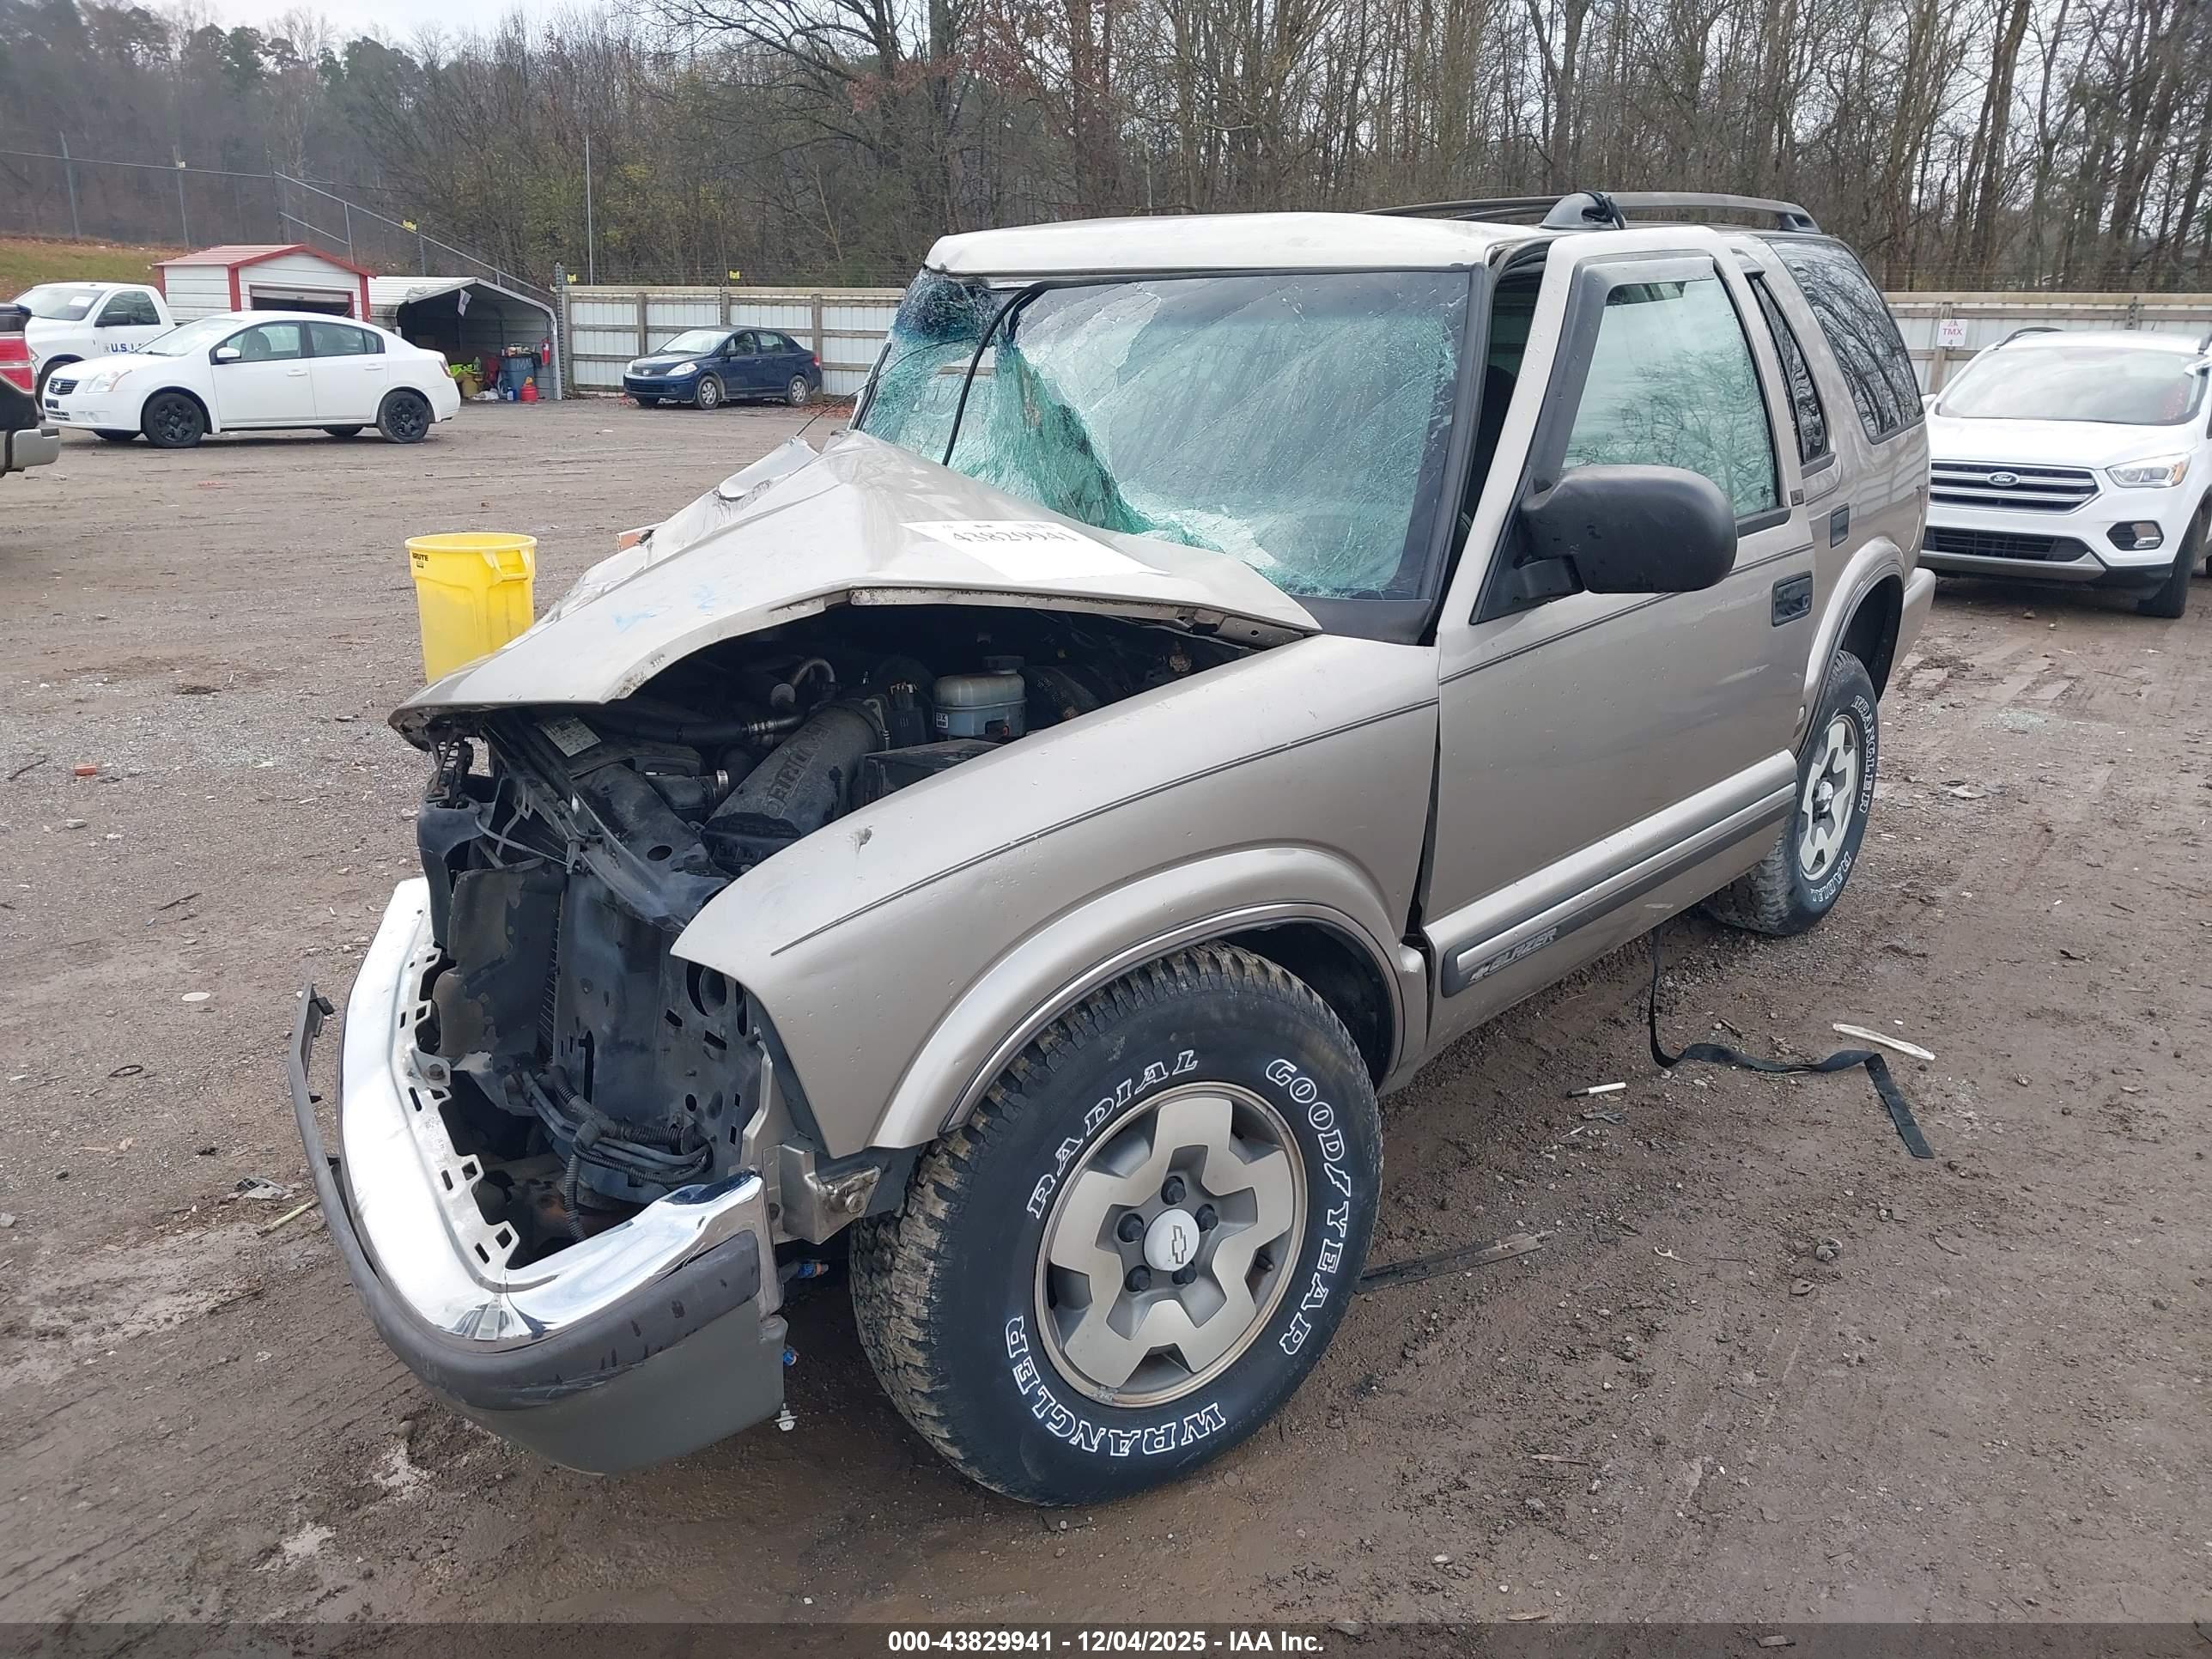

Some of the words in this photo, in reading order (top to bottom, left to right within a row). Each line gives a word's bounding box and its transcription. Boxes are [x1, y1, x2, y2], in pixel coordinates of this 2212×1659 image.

[1942, 327, 1964, 336] TMX
[1993, 474, 2013, 483] Ford
[412, 552, 428, 562] BRUTE
[952, 531, 1079, 543] 43829941
[1850, 695, 1875, 814] WRANGLER
[1810, 851, 1852, 902] RADIAL
[1489, 927, 1557, 972] BLAZER
[1026, 1049, 1200, 1219] RADIAL
[1004, 1315, 1226, 1457] WRANGLER
